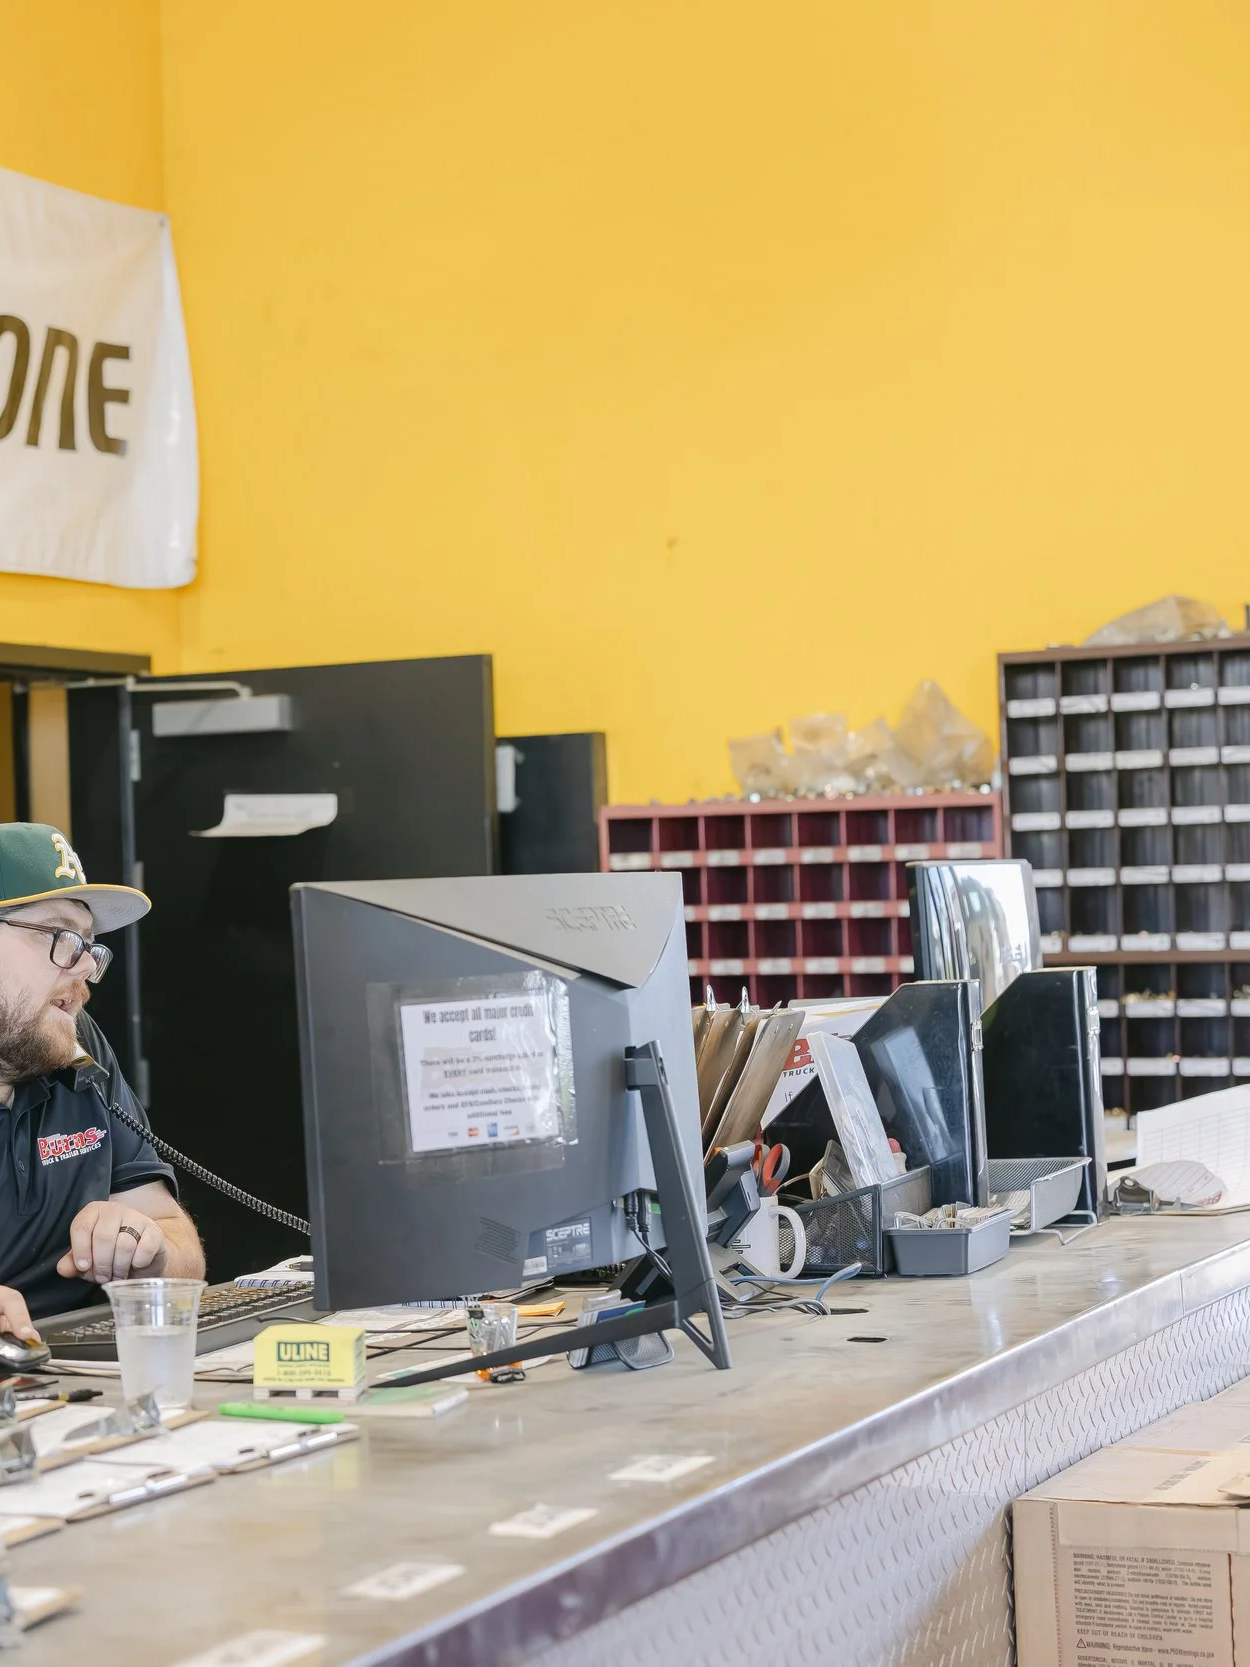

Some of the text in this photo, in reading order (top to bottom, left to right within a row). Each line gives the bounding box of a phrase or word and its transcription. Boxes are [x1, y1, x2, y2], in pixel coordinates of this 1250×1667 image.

[423, 1002, 534, 1024] We accept all major credit
[469, 1027, 497, 1043] cards!
[782, 1066, 815, 1078] TRUCK
[545, 1222, 591, 1242] SCEPTRE
[279, 1342, 329, 1361] ULINE
[1077, 1628, 1090, 1636] KEEP
[1091, 1629, 1102, 1637] OUT
[1111, 1631, 1128, 1639] REACH
